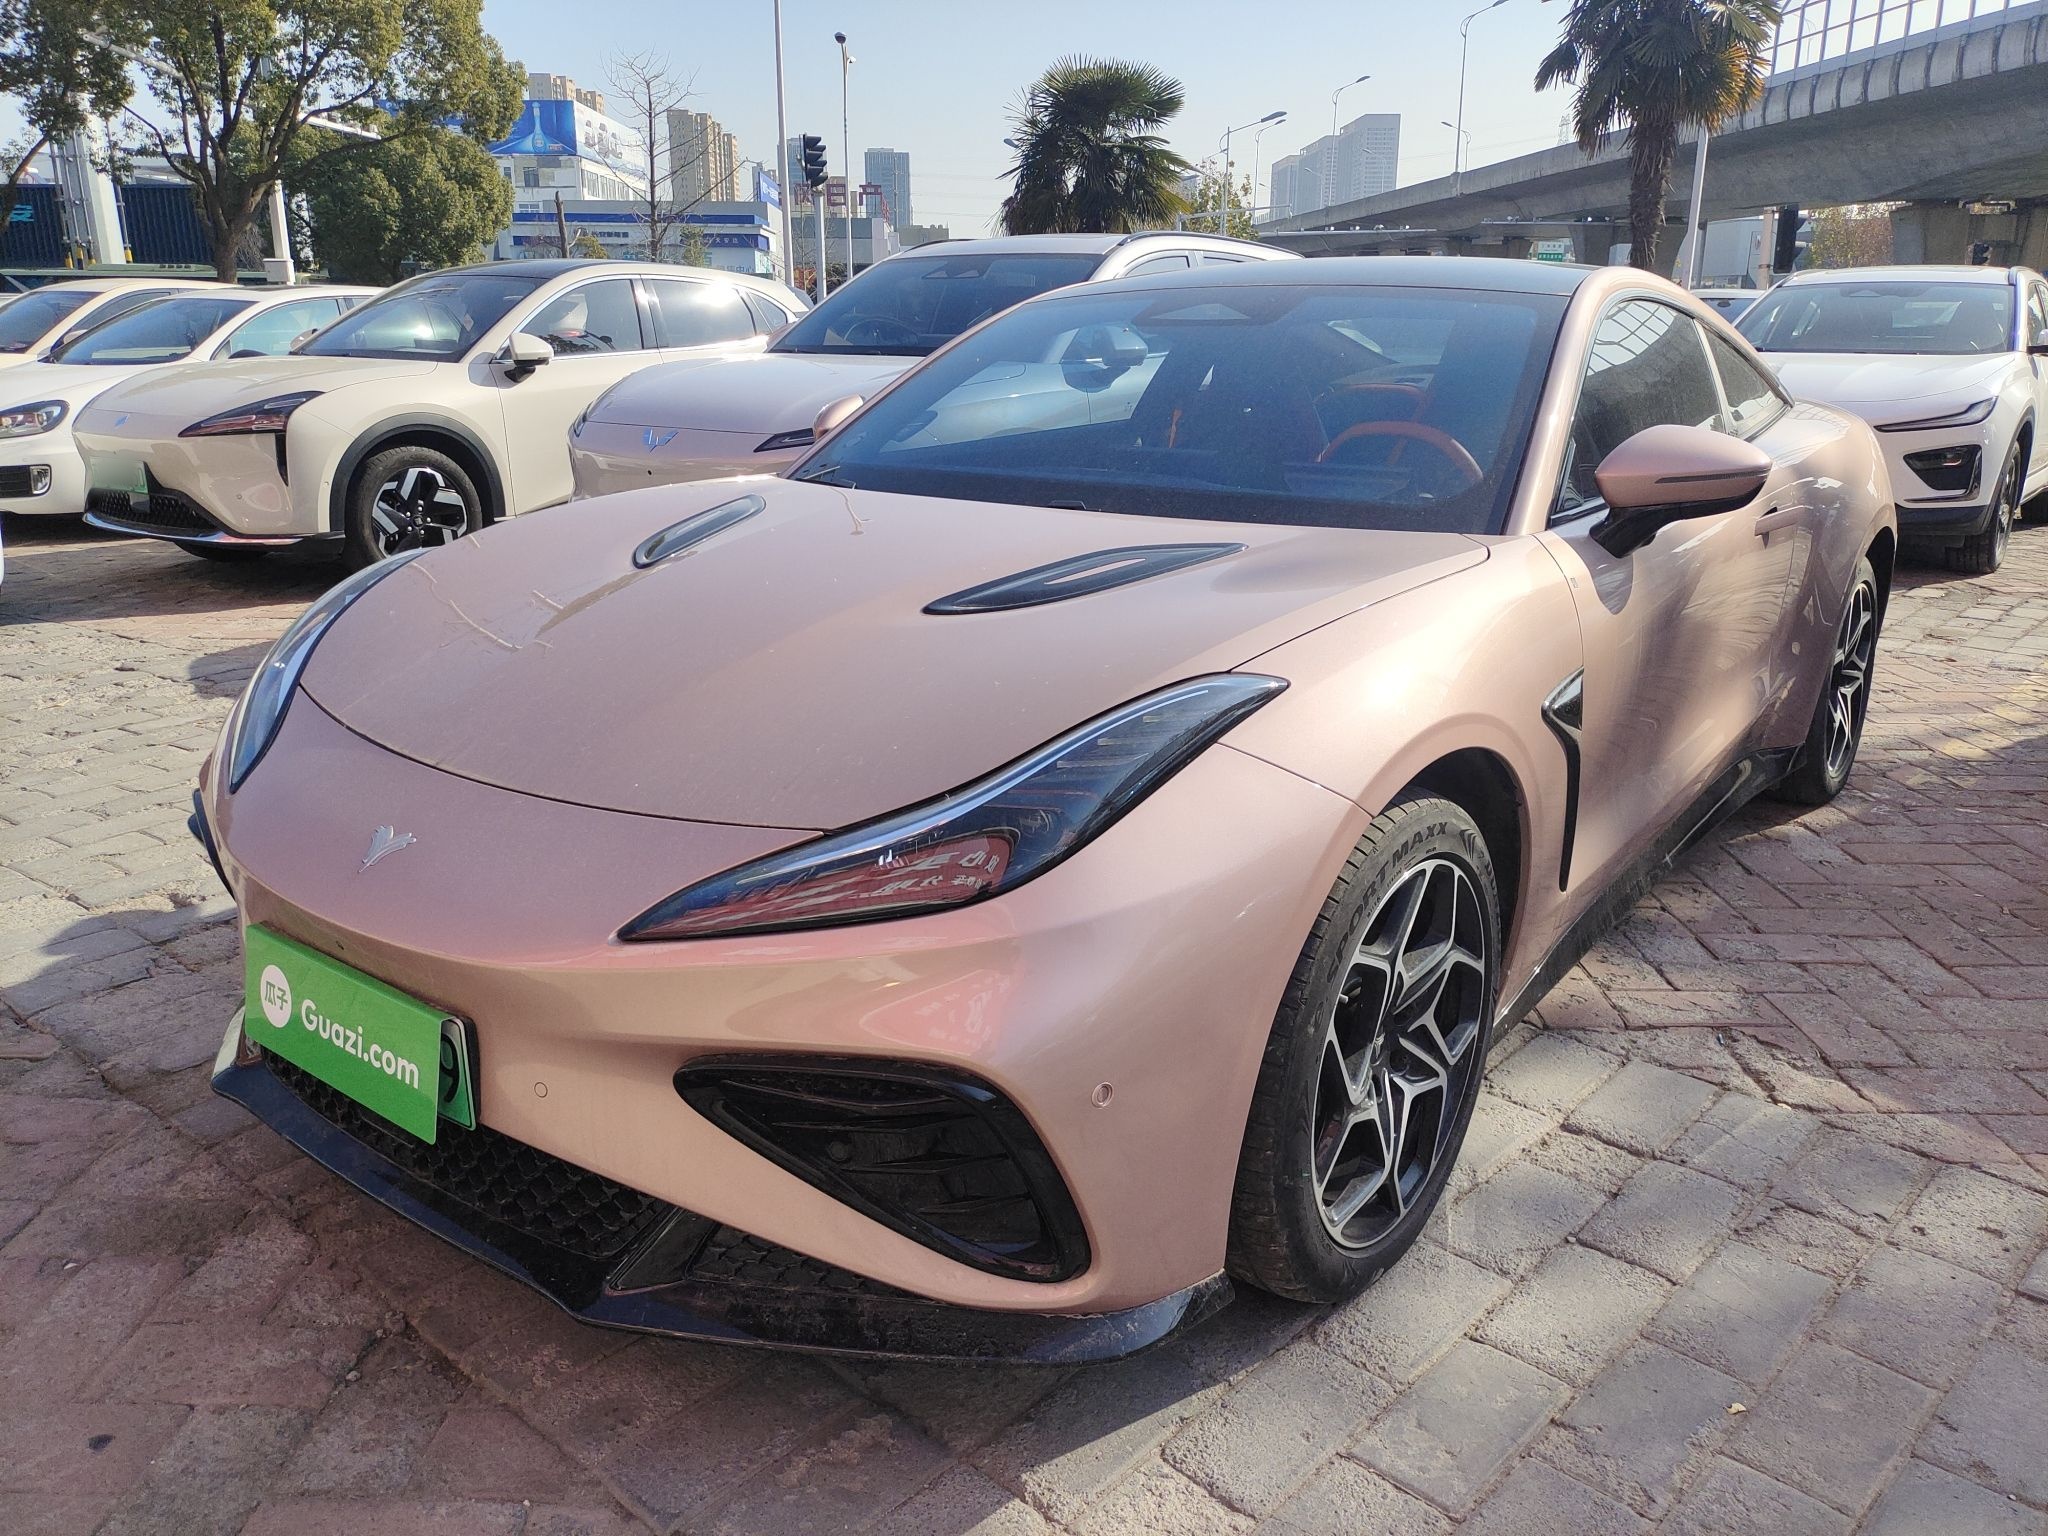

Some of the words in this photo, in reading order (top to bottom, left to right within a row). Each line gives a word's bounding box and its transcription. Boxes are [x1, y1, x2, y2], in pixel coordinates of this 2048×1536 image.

[1327, 861, 1389, 982] SPORT
[1392, 822, 1448, 868] MAXX
[265, 981, 288, 1010] 瓜子
[302, 999, 419, 1089] Guazi.com
